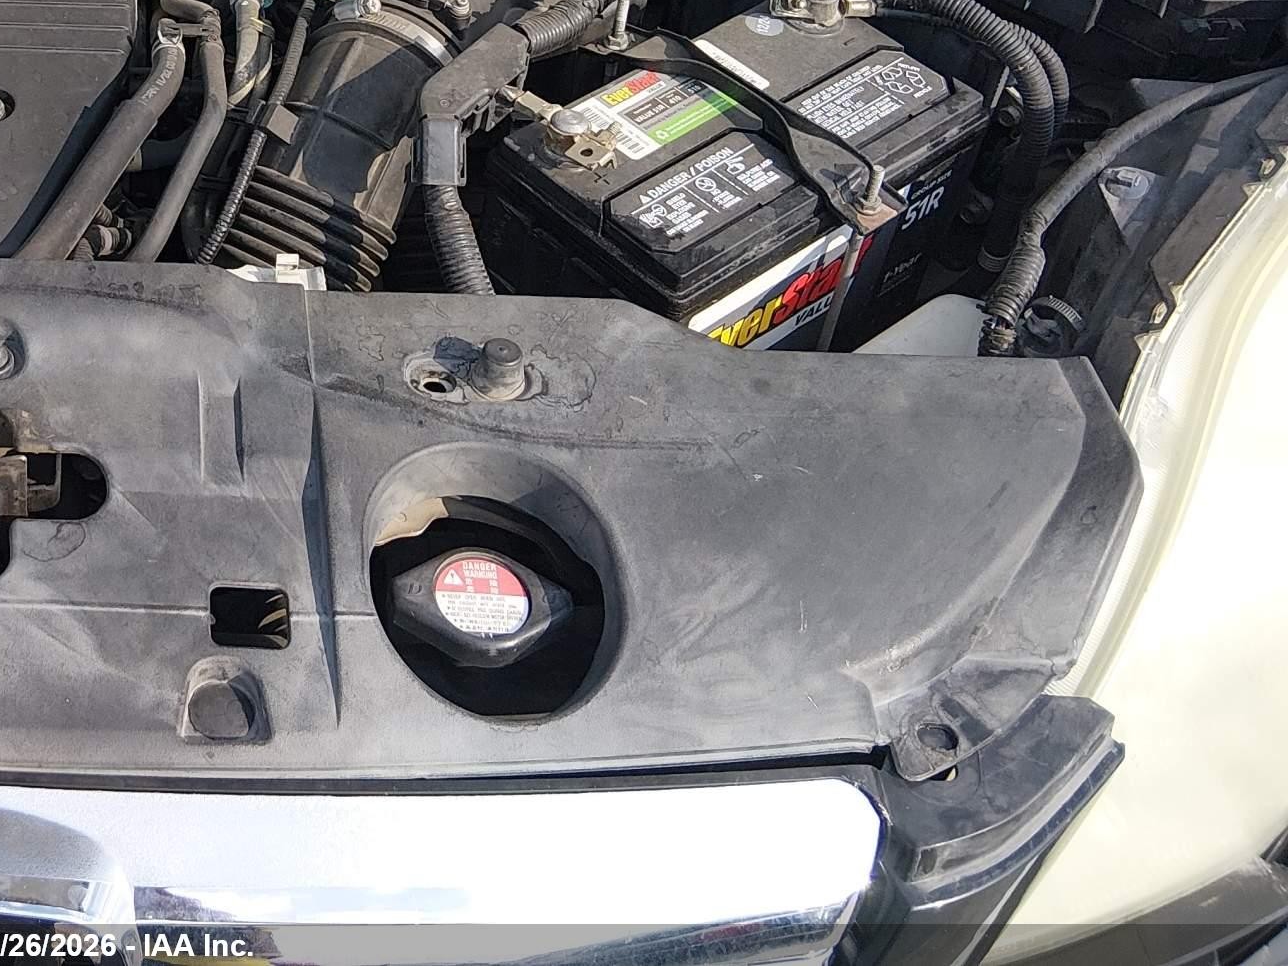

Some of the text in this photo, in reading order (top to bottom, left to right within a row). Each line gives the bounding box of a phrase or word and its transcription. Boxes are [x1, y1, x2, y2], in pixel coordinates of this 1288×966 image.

[646, 169, 691, 199] DANGER
[694, 145, 733, 172] POISON
[901, 186, 945, 231] 51R
[462, 561, 497, 571] DANGER
